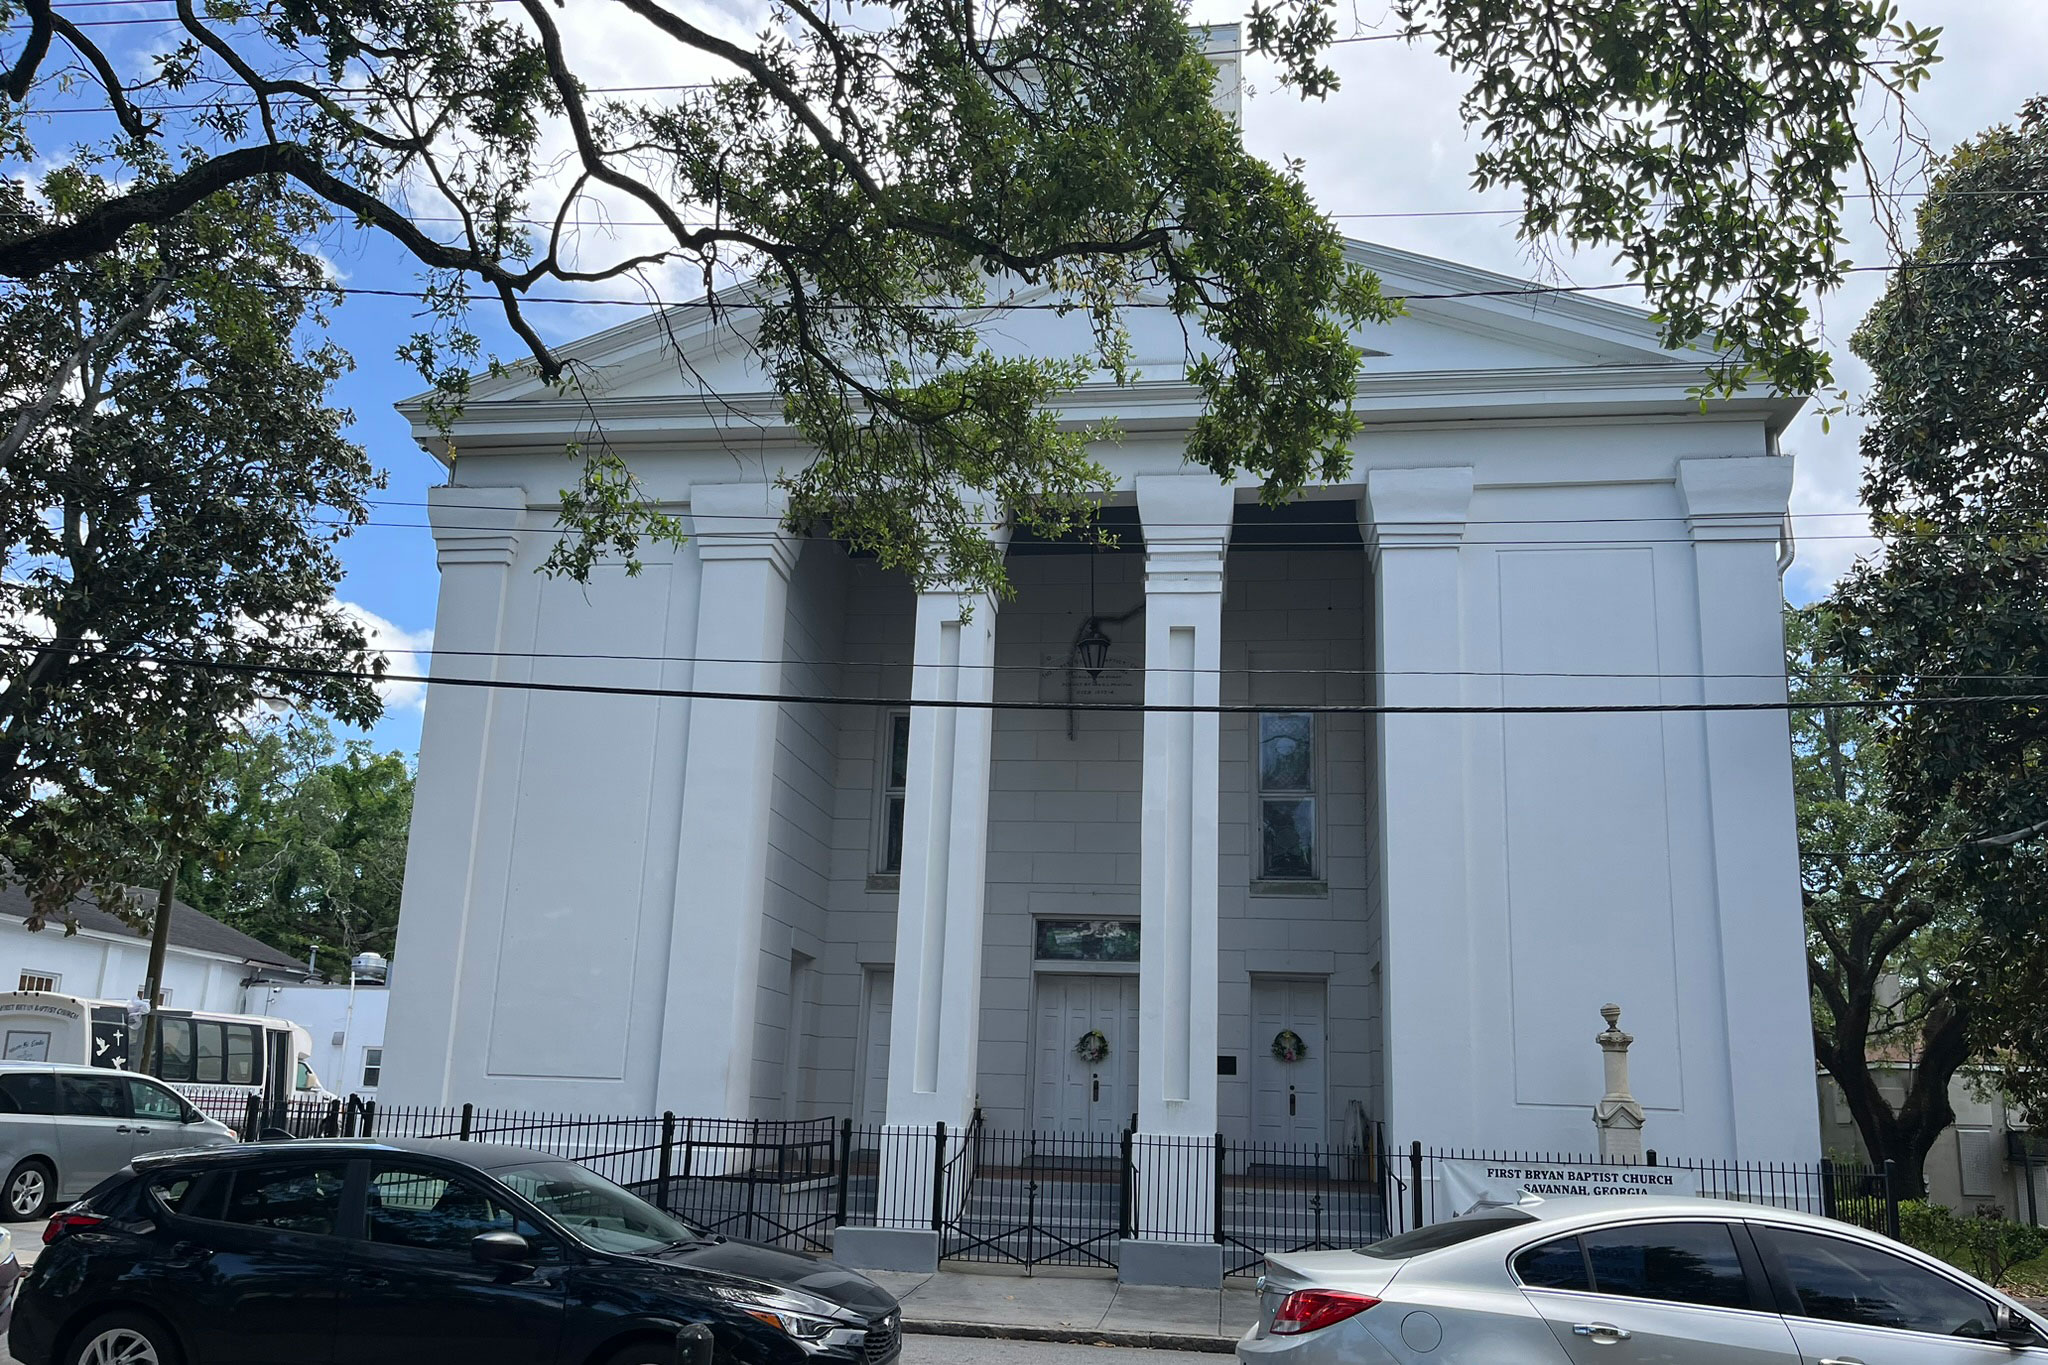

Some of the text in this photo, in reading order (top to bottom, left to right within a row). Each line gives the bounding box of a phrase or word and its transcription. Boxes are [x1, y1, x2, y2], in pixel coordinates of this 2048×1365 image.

[1487, 1168, 1674, 1185] FIRST BRYAN BAPTIST CHURCH
